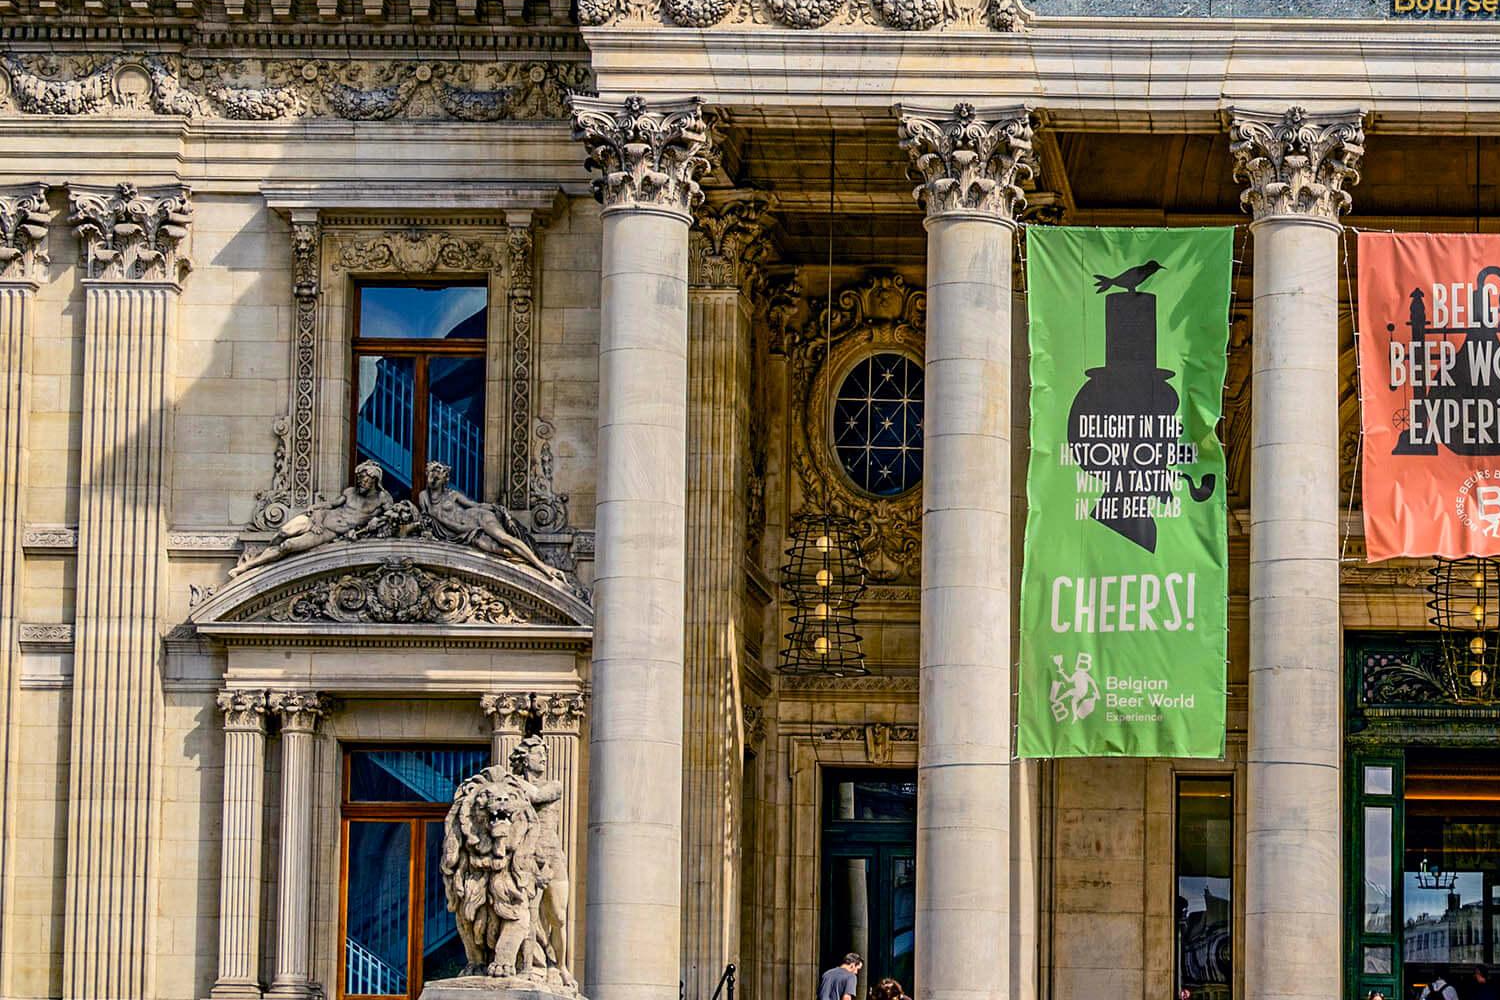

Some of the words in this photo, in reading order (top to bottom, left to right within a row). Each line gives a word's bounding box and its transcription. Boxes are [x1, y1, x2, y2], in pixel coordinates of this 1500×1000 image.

[1390, 340, 1456, 387] BEER
[1158, 415, 1183, 438] THE
[1133, 443, 1163, 466] OF
[1167, 443, 1198, 465] BEER
[1115, 471, 1124, 493] A
[1094, 497, 1119, 520] THE
[1123, 496, 1182, 520] BEERLAB
[1051, 572, 1196, 633] CHEERS!
[1106, 676, 1168, 693] Belgian
[1105, 693, 1144, 708] Beer
[1147, 693, 1194, 709] World
[1105, 712, 1164, 723] Experience
